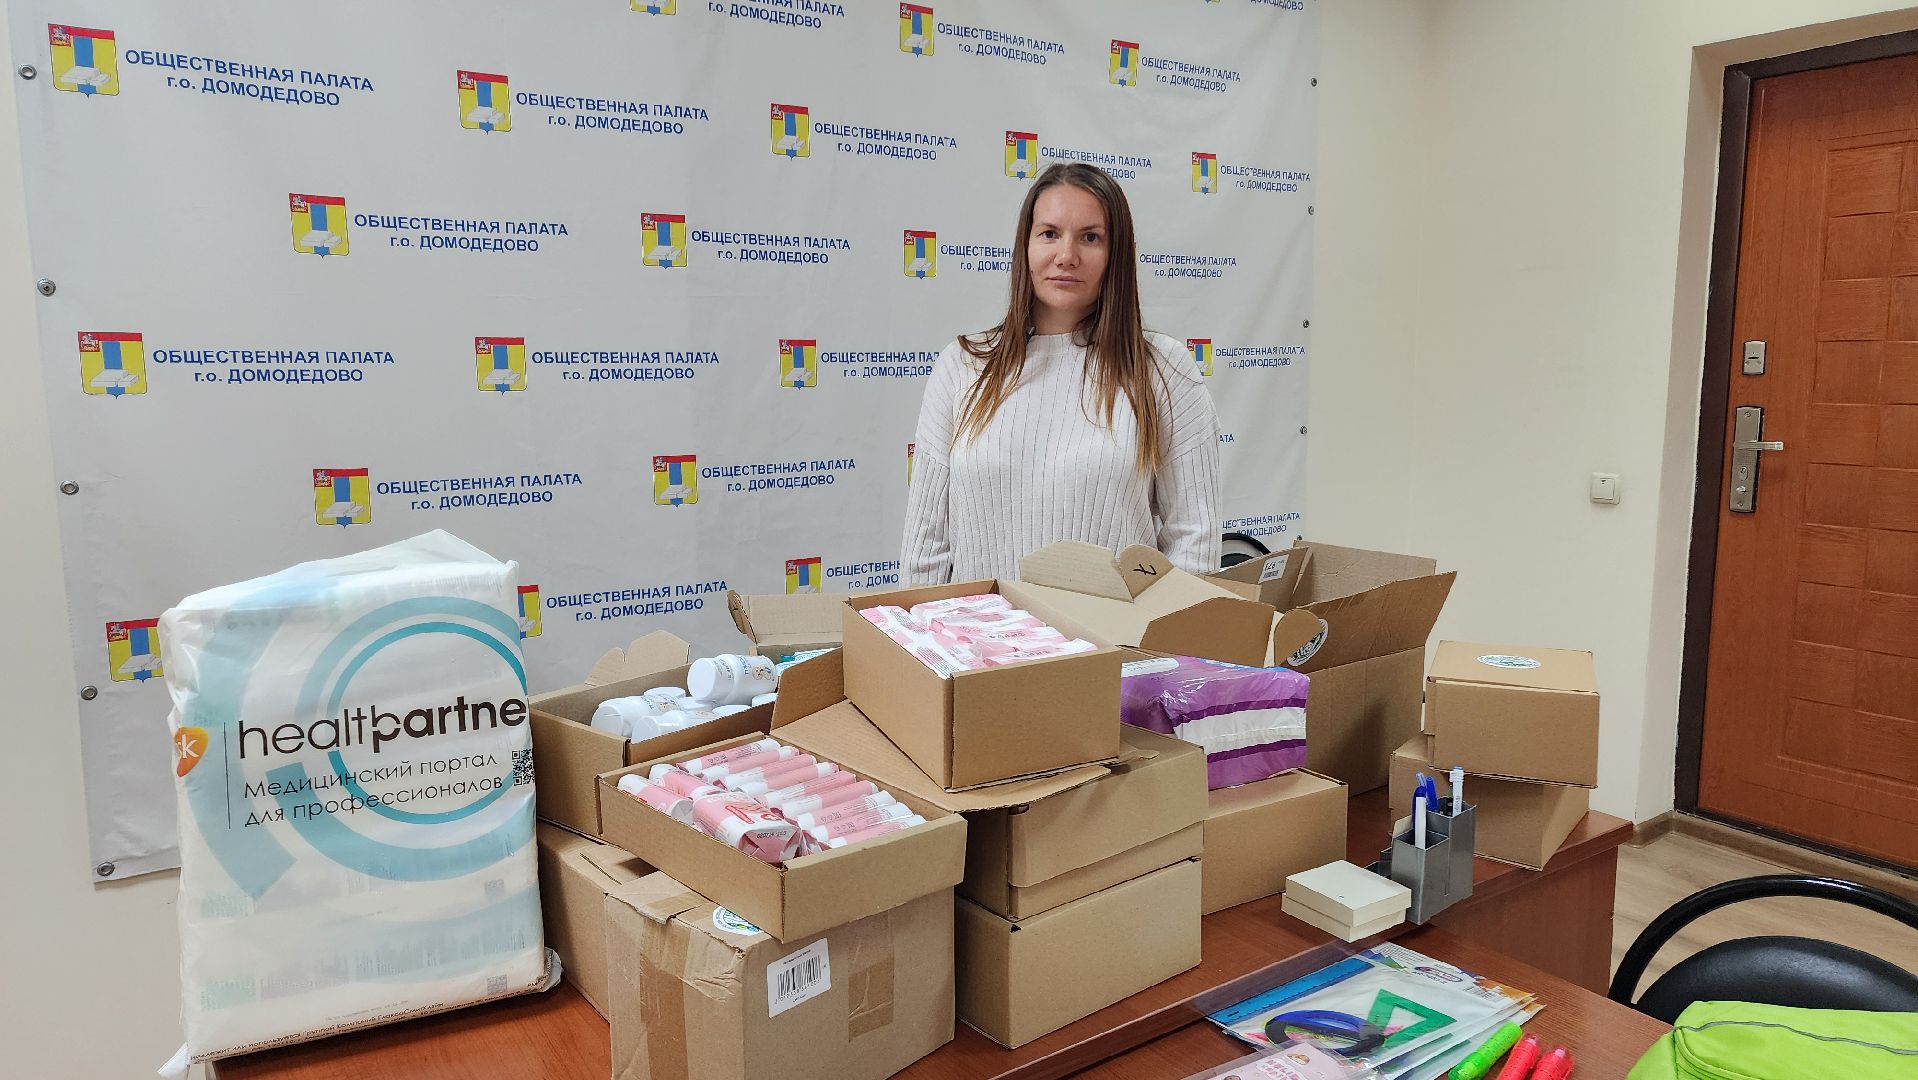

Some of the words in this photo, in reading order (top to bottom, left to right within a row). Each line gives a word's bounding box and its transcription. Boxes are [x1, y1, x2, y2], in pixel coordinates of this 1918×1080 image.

[729, 3, 821, 28] ДОМОДЕДОВО
[937, 22, 1025, 47] ОБЩЕСТВЕННАЯ
[1027, 39, 1065, 54] ПАЛАТА
[975, 44, 1047, 65] ДОМОДЕДОВО
[125, 49, 294, 83] ОБЩЕСТВЕННАЯ
[300, 70, 375, 92] ПАЛАТА
[1141, 56, 1211, 76] ОБЩЕСТВЕННАЯ
[1212, 68, 1241, 83] ПАЛАТА
[166, 76, 198, 90] г.о.
[201, 77, 340, 106] ДОМОДЕДОВО
[1169, 75, 1227, 92] ДОМОДЕДОВО
[515, 92, 649, 116] ОБЩЕСТВЕННАЯ
[653, 104, 709, 121] ПАЛАТА
[548, 115, 572, 126] г.о.
[574, 114, 684, 135] ДОМОДЕДОВО
[814, 122, 912, 143] ОБЩЕСТВЕННАЯ
[914, 133, 957, 148] ПАЛАТА
[838, 142, 855, 153] г.о.
[857, 142, 937, 161] ДОМОДЕДОВО
[1041, 146, 1116, 165] ОБЩЕСТВЕННАЯ
[1118, 156, 1152, 169] ПАЛАТА
[1220, 165, 1281, 179] ОБЩЕСТВЕННАЯ
[1282, 171, 1311, 182] ПАЛАТА
[1246, 180, 1298, 193] ДОМОДЕДОВО
[354, 213, 500, 234] ОБЩЕСТВЕННАЯ
[505, 221, 569, 236] ПАЛАТА
[390, 236, 416, 247] г.о.
[419, 234, 539, 253] ДОМОДЕДОВО
[691, 230, 800, 247] ОБЩЕСТВЕННАЯ
[803, 236, 850, 250] ПАЛАТА
[717, 250, 737, 261] г.о.
[739, 248, 829, 266] ДОМОДЕДОВО
[940, 244, 1013, 259] ОБЩЕСТВЕНН
[1139, 253, 1207, 266] ОБЩЕСТВЕННАЯ
[1208, 256, 1237, 266] ПАЛАТА
[1168, 267, 1222, 279] ДОМОДЕДОВО
[152, 349, 320, 366] ОБЩЕСТВЕННАЯ
[325, 351, 395, 364] ПАЛАТА
[531, 351, 661, 366] ОБЩЕСТВЕННАЯ
[664, 351, 720, 364] ПАЛАТА
[820, 351, 915, 364] ОБЩЕСТВЕННАЯ
[1215, 347, 1278, 358] ОБЩЕСТВЕННАЯ
[1278, 346, 1306, 355] ПАЛАТА
[862, 366, 933, 378] ДОМОДЕДОВ
[1239, 357, 1291, 370] ДОМОДЕДОВО
[194, 371, 223, 384] г.о.
[227, 368, 363, 386] ДОМОДЕДОВО
[562, 371, 585, 382] г.о.
[588, 367, 695, 384] ДОМОДЕДОВО
[701, 462, 808, 480] ОБЩЕСТВЕННАЯ
[809, 458, 856, 472] ПАЛАТА
[376, 476, 515, 496] ОБЩЕСТВЕННАЯ
[520, 473, 583, 488] ПАЛАТА
[726, 481, 746, 492] г.о.
[747, 474, 835, 492] ДОМОДЕДОВО
[411, 499, 435, 511] г.о.
[438, 490, 553, 511] ДОМОДЕДОВО
[546, 585, 671, 610] ОБЩЕСТВЕННАЯ
[674, 581, 728, 598] ПАЛАТА
[575, 610, 597, 622] г.о.
[600, 598, 704, 622] ДОМОДЕДОВО
[244, 760, 413, 799] Медицинский
[420, 754, 498, 775] портал
[244, 807, 284, 828] для
[293, 776, 504, 820] профессионалов
